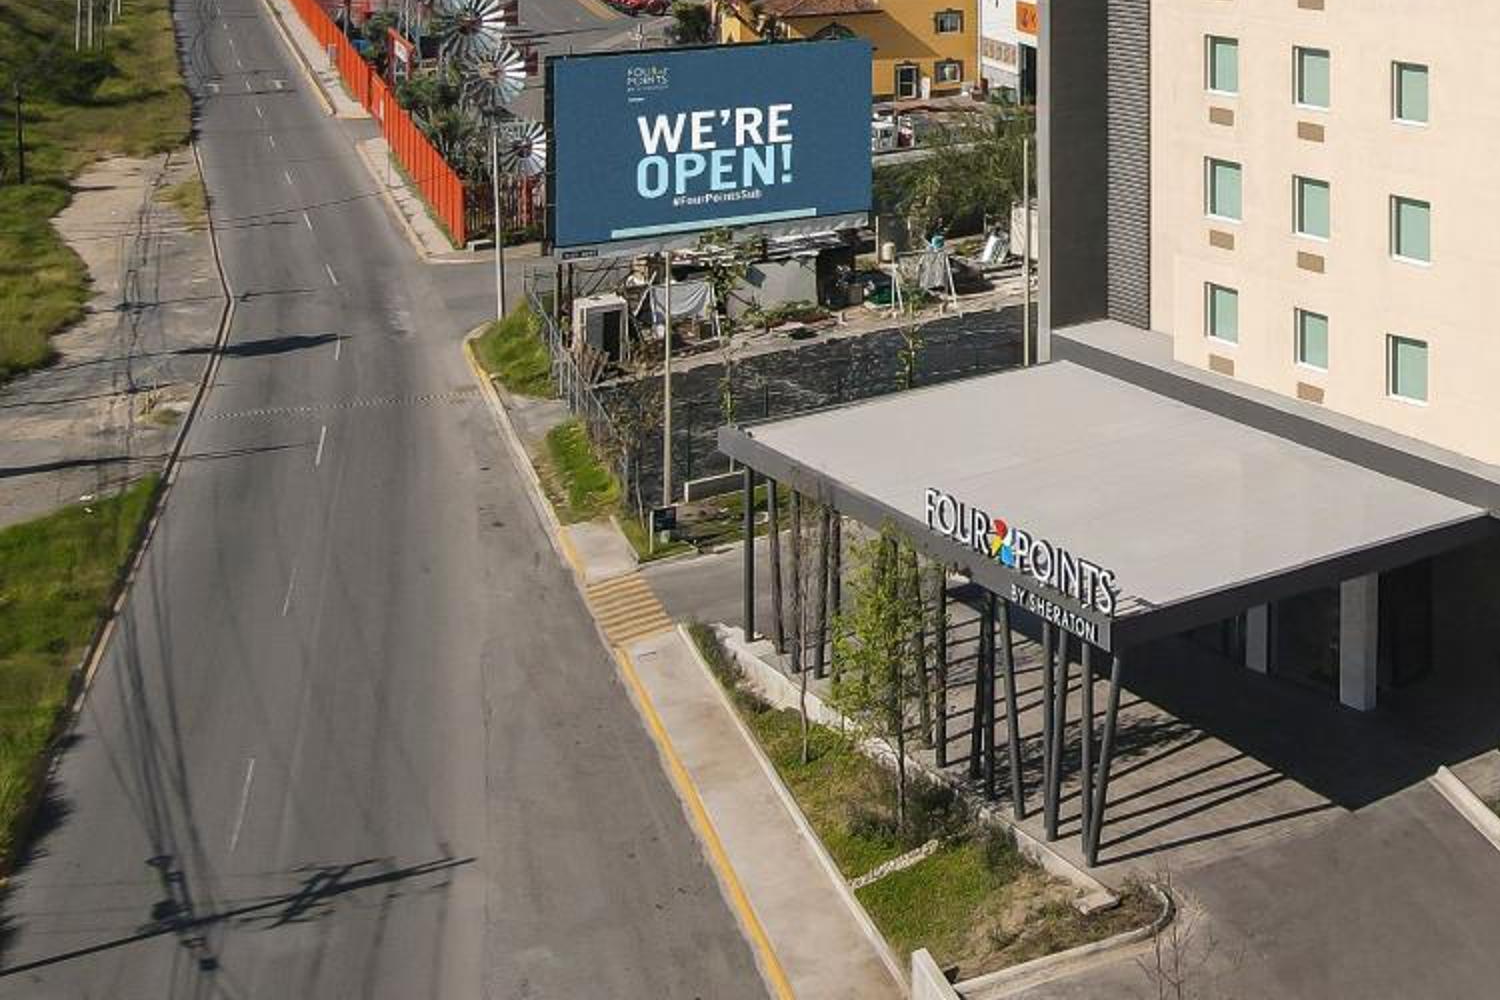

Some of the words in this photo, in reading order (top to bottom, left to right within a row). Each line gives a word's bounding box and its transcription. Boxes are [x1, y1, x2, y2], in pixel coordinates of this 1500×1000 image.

[638, 103, 793, 155] WE'RE
[637, 144, 793, 199] OPEN!
[925, 488, 991, 555] FOUR
[1014, 529, 1117, 614] POINTS
[1011, 583, 1026, 607] BY
[1029, 593, 1096, 643] SHERATON
